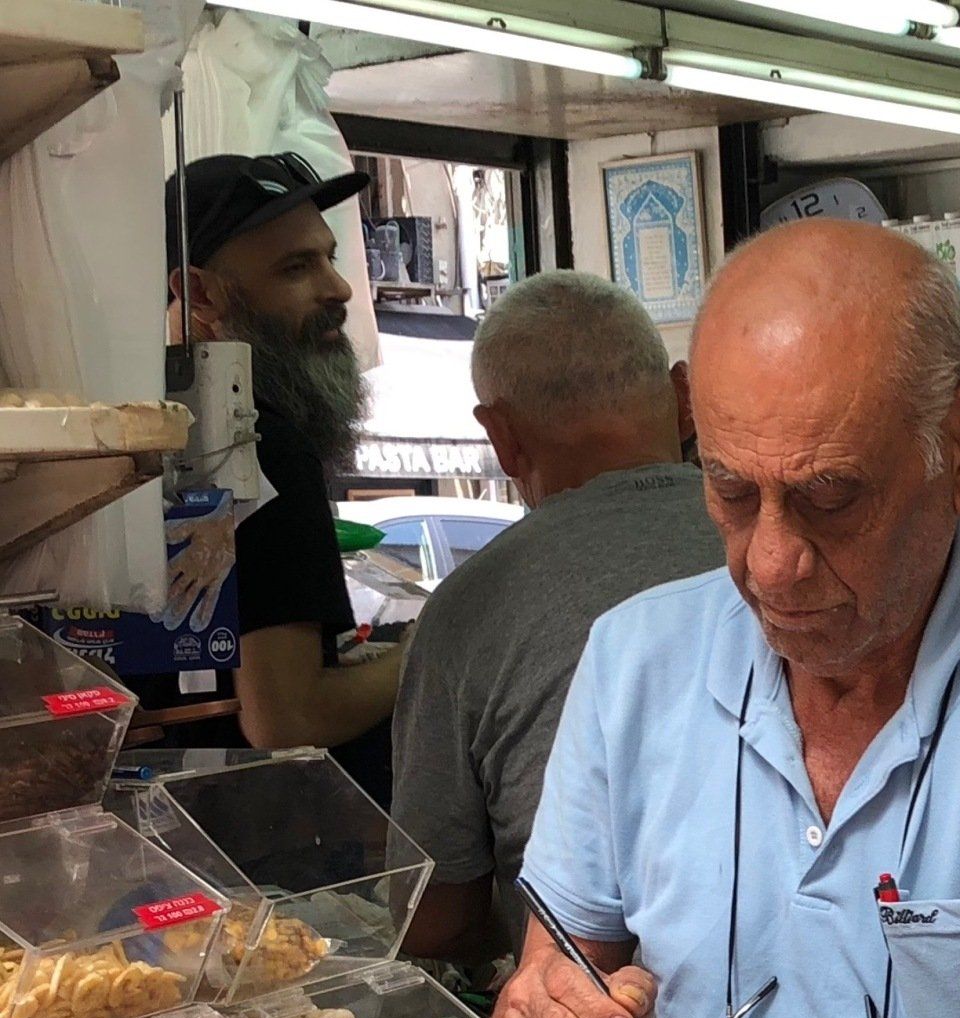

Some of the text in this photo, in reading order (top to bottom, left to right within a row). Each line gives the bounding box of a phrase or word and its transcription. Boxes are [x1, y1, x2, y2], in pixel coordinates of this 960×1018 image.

[791, 193, 824, 219] 12
[356, 443, 482, 473] PASTA BAR
[211, 640, 234, 652] 100
